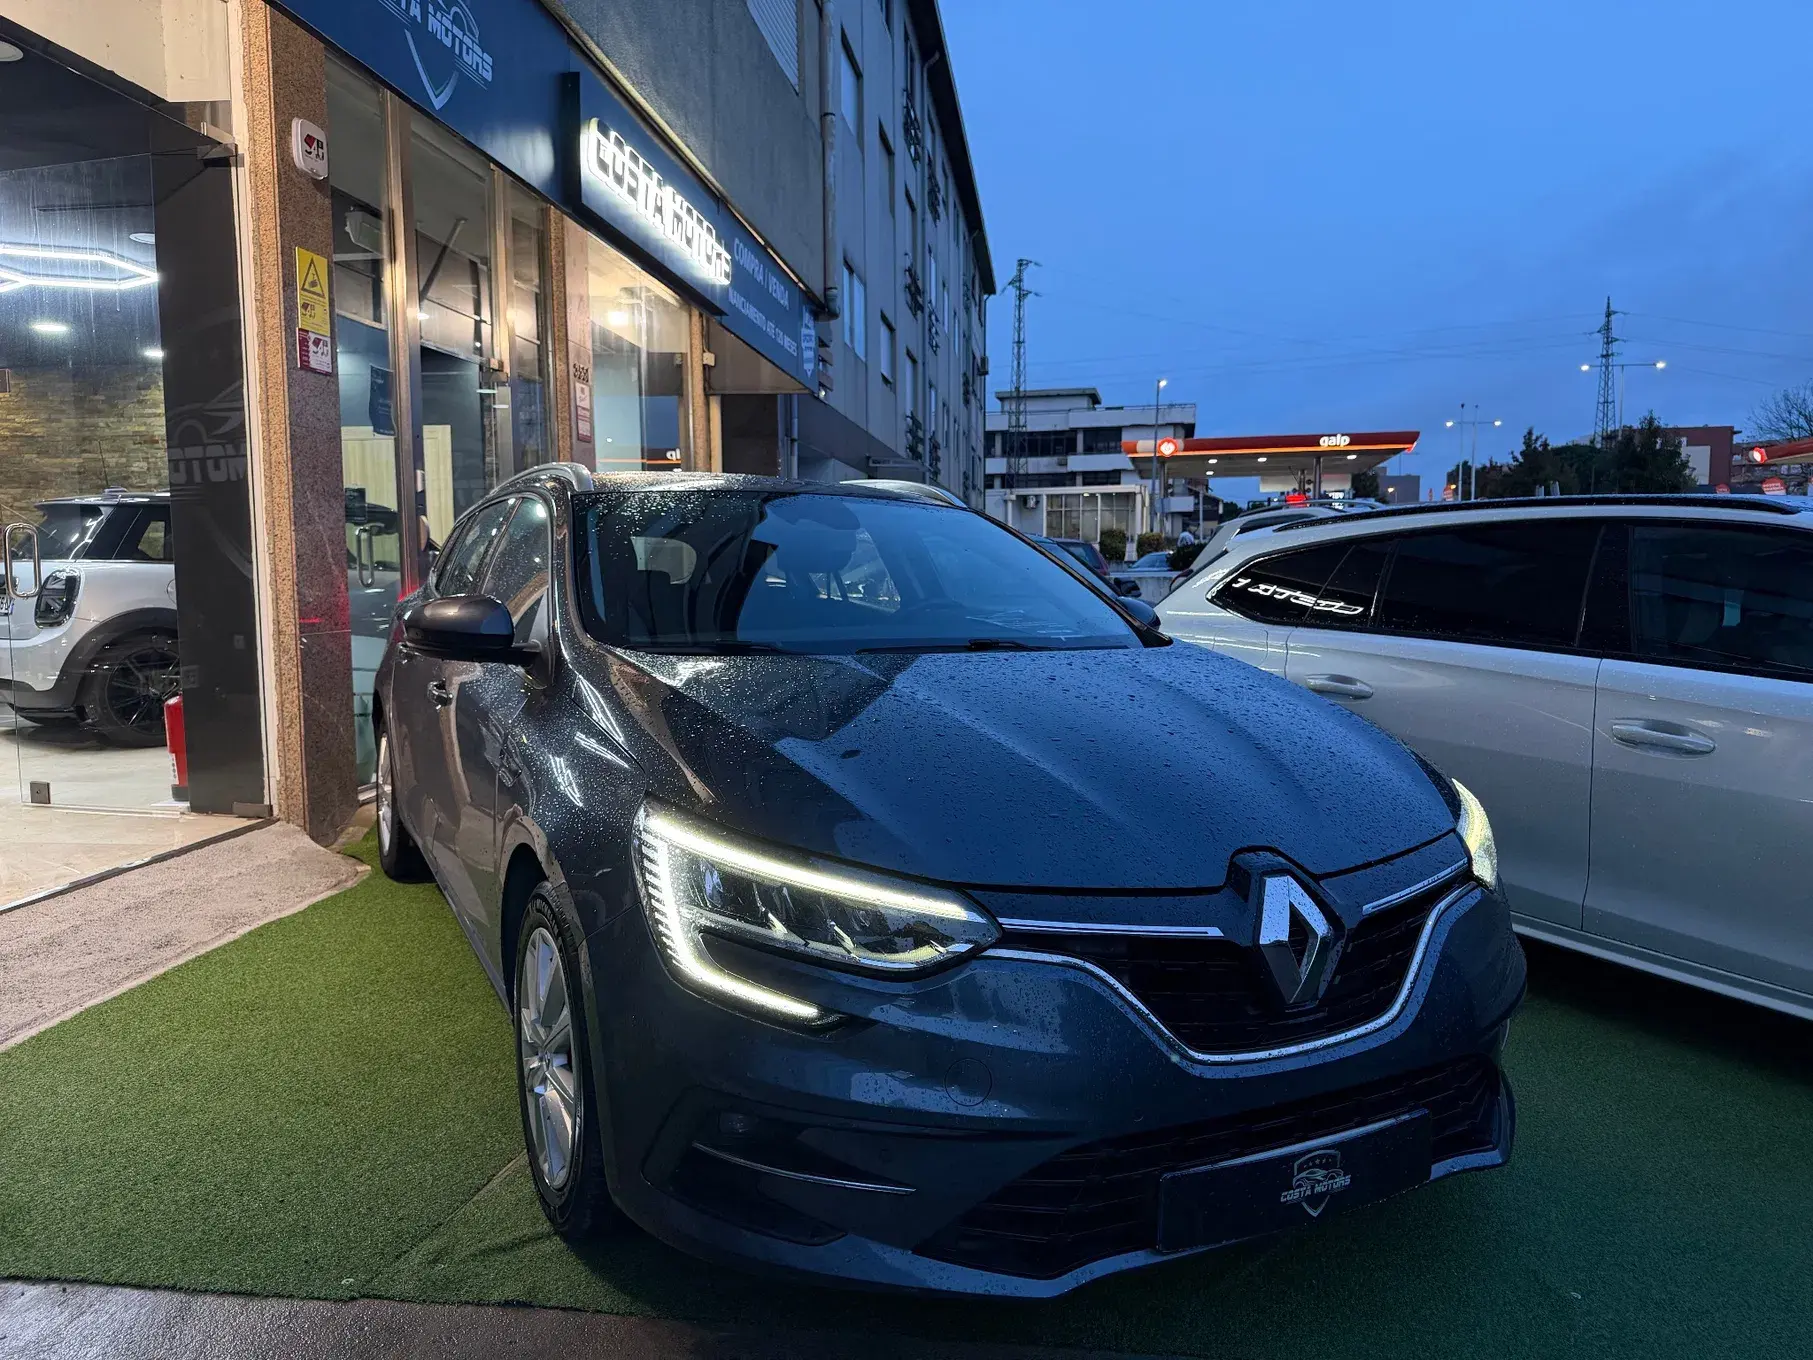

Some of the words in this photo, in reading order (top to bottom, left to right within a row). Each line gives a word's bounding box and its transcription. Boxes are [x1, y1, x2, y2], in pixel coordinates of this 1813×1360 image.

[428, 3, 493, 82] MOTORS
[581, 117, 664, 234] COSTA
[660, 185, 732, 286] MOTORS
[734, 238, 764, 286] COMPRA
[768, 272, 789, 311] VENDA
[1320, 433, 1350, 448] galp
[1280, 1186, 1311, 1203] COSTA
[1314, 1174, 1352, 1194] MOTORS
